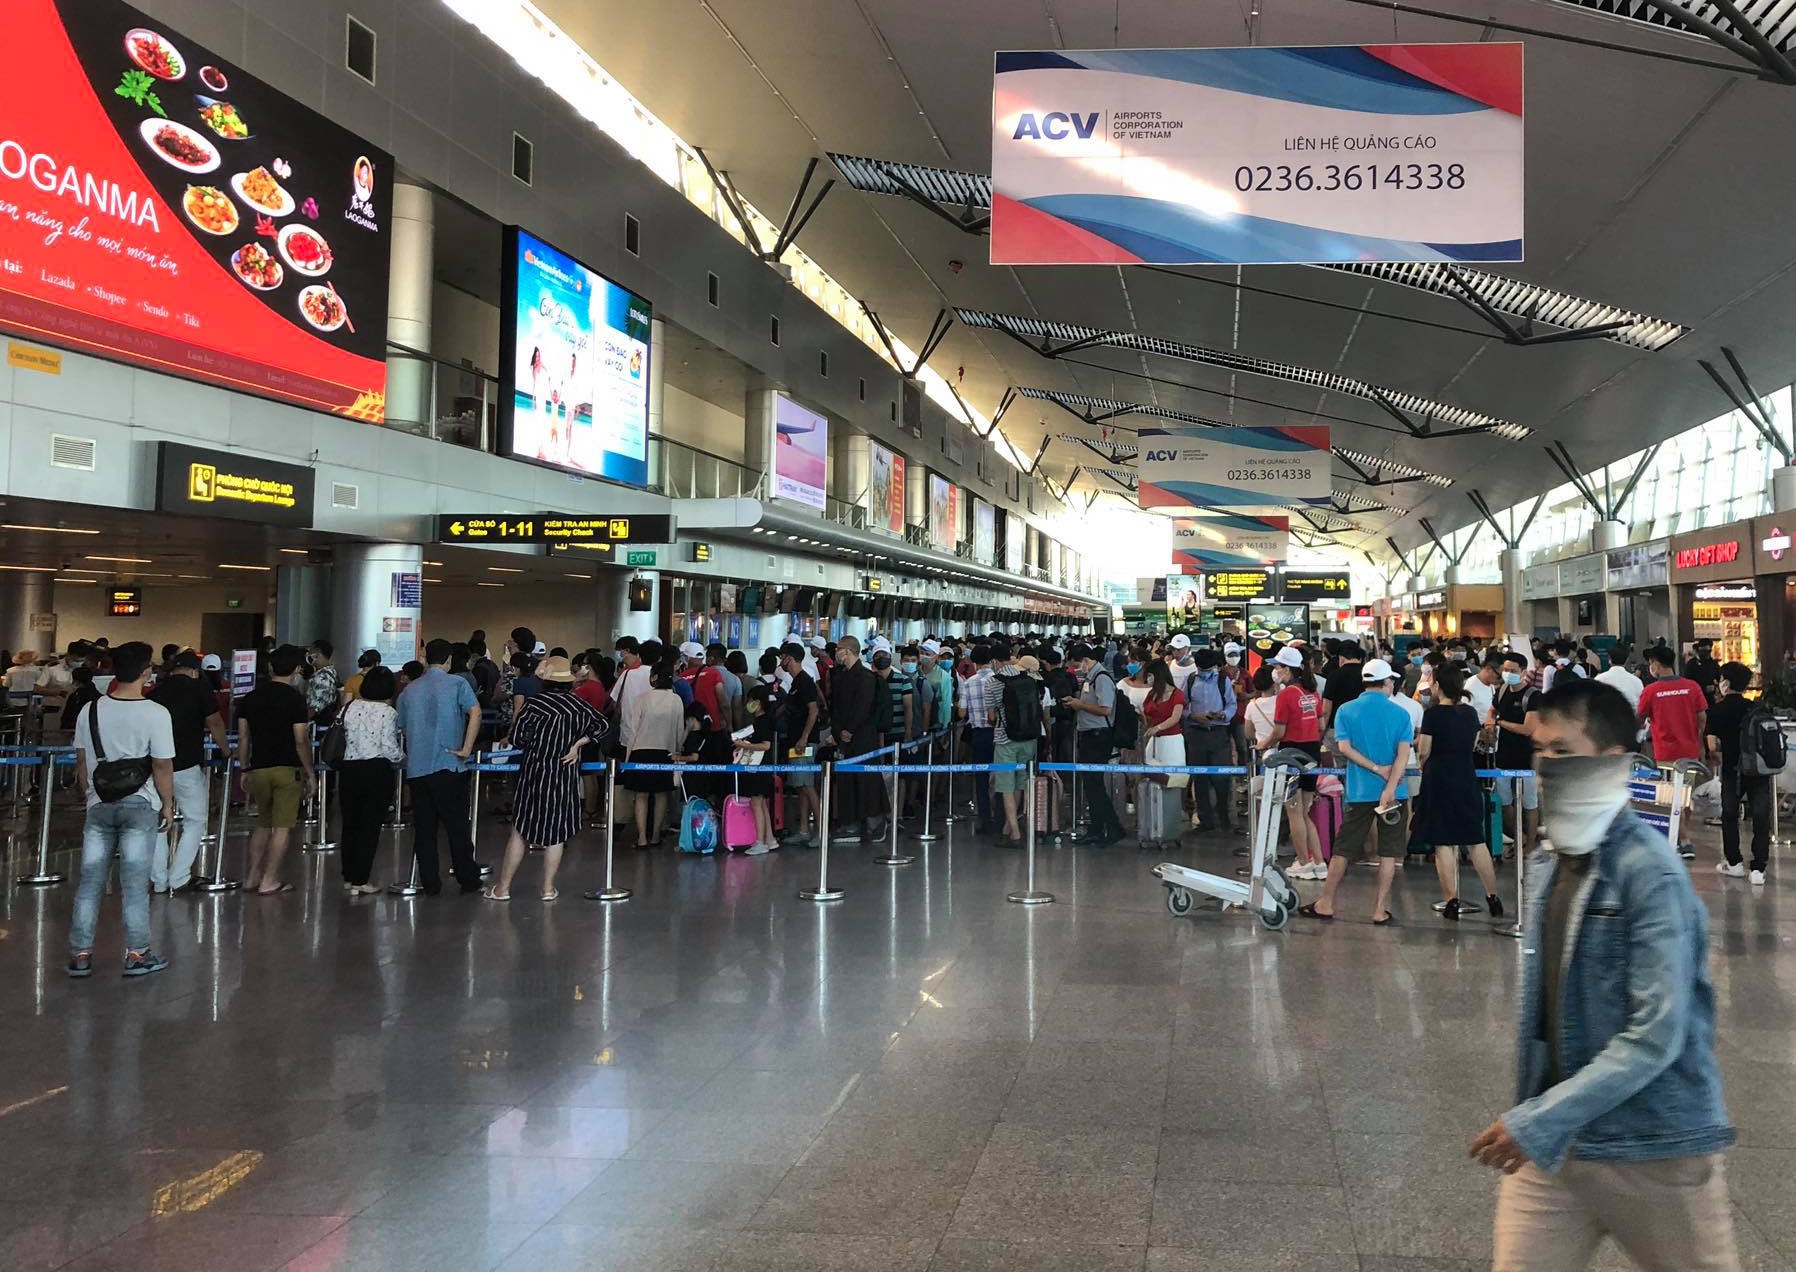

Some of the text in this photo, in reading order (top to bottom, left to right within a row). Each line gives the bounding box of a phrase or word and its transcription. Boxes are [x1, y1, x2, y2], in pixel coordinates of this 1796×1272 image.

[1114, 112, 1162, 120] AIRPORTS
[1013, 112, 1099, 140] ACV
[1114, 121, 1183, 130] CORPORATION
[1113, 131, 1171, 139] OF VIETNAM
[1284, 134, 1436, 152] LIÊN HỆ QUẢNG CÁO
[1235, 163, 1465, 192] 0236.3614338
[345, 210, 378, 232] LAOGANMA
[25, 210, 63, 246] năng
[69, 217, 91, 241] cho
[98, 238, 122, 254] mọi
[127, 246, 157, 268] món
[41, 269, 75, 290] Lazada
[93, 285, 127, 305] Shopee
[143, 301, 169, 318] Sendo
[1146, 450, 1178, 461] ACV
[1227, 469, 1311, 480] 0236.3614338
[544, 529, 571, 537] Security
[630, 553, 648, 563] EXIT
[1676, 541, 1738, 569] LUCKY GIFT SHOP
